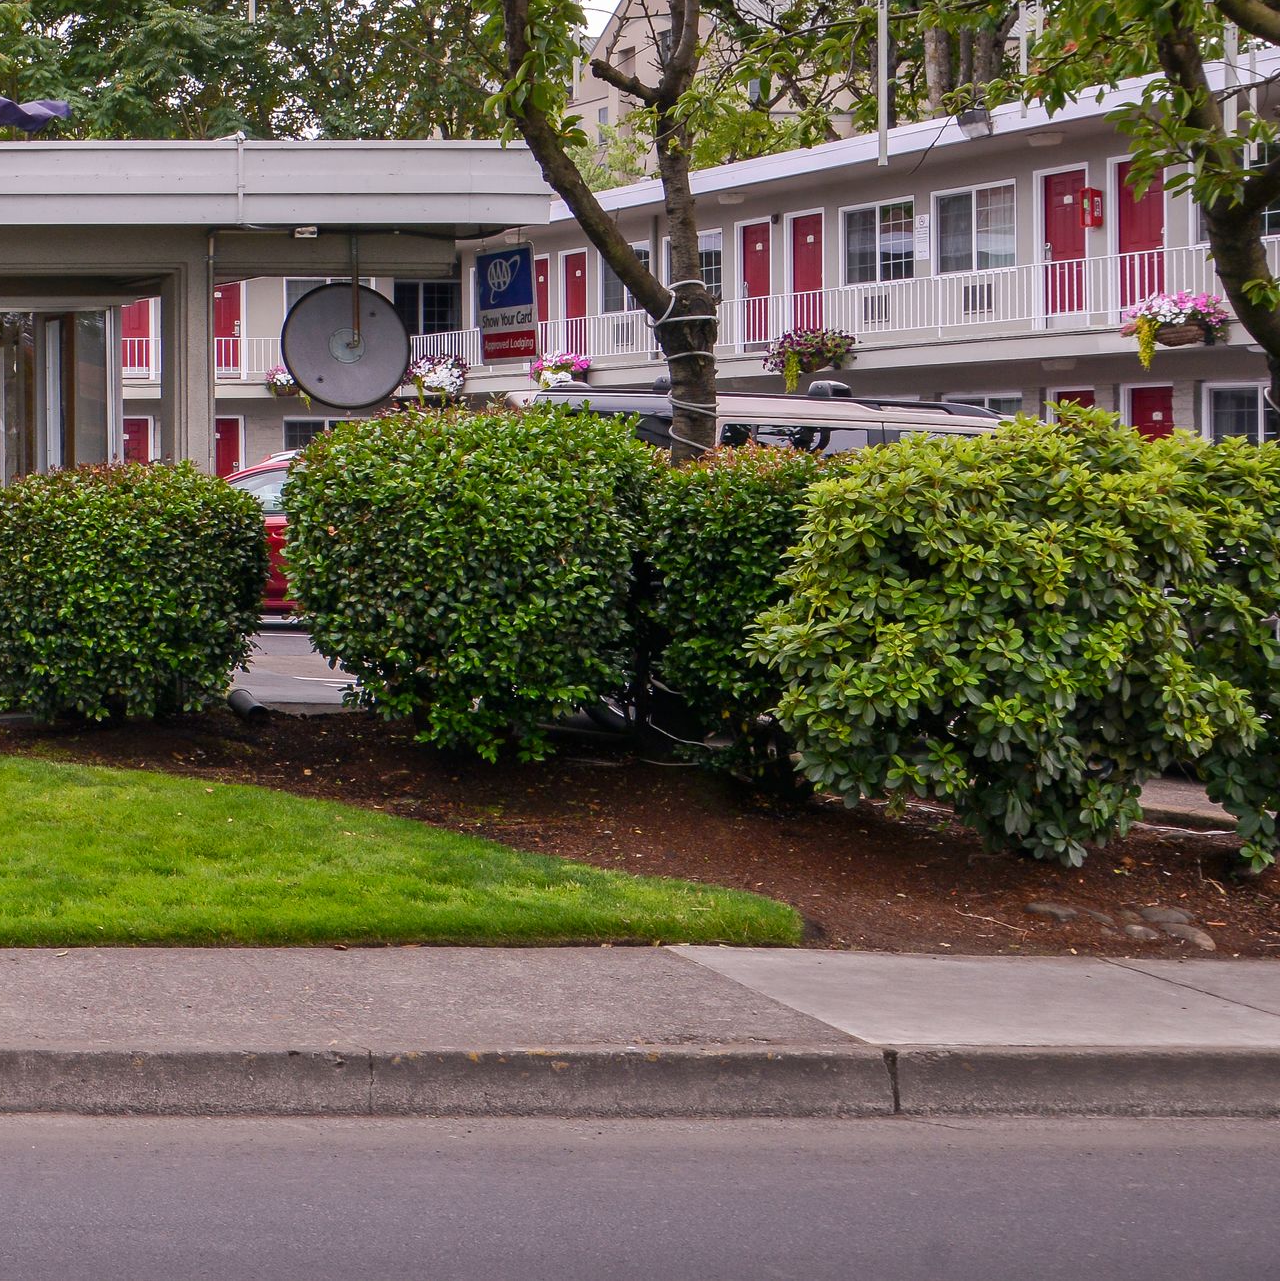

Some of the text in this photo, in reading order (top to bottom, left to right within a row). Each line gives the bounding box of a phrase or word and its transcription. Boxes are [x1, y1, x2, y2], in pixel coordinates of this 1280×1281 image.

[489, 260, 509, 290] AAA
[482, 309, 533, 328] Show Your Card
[485, 337, 534, 352] Approved Lodging
